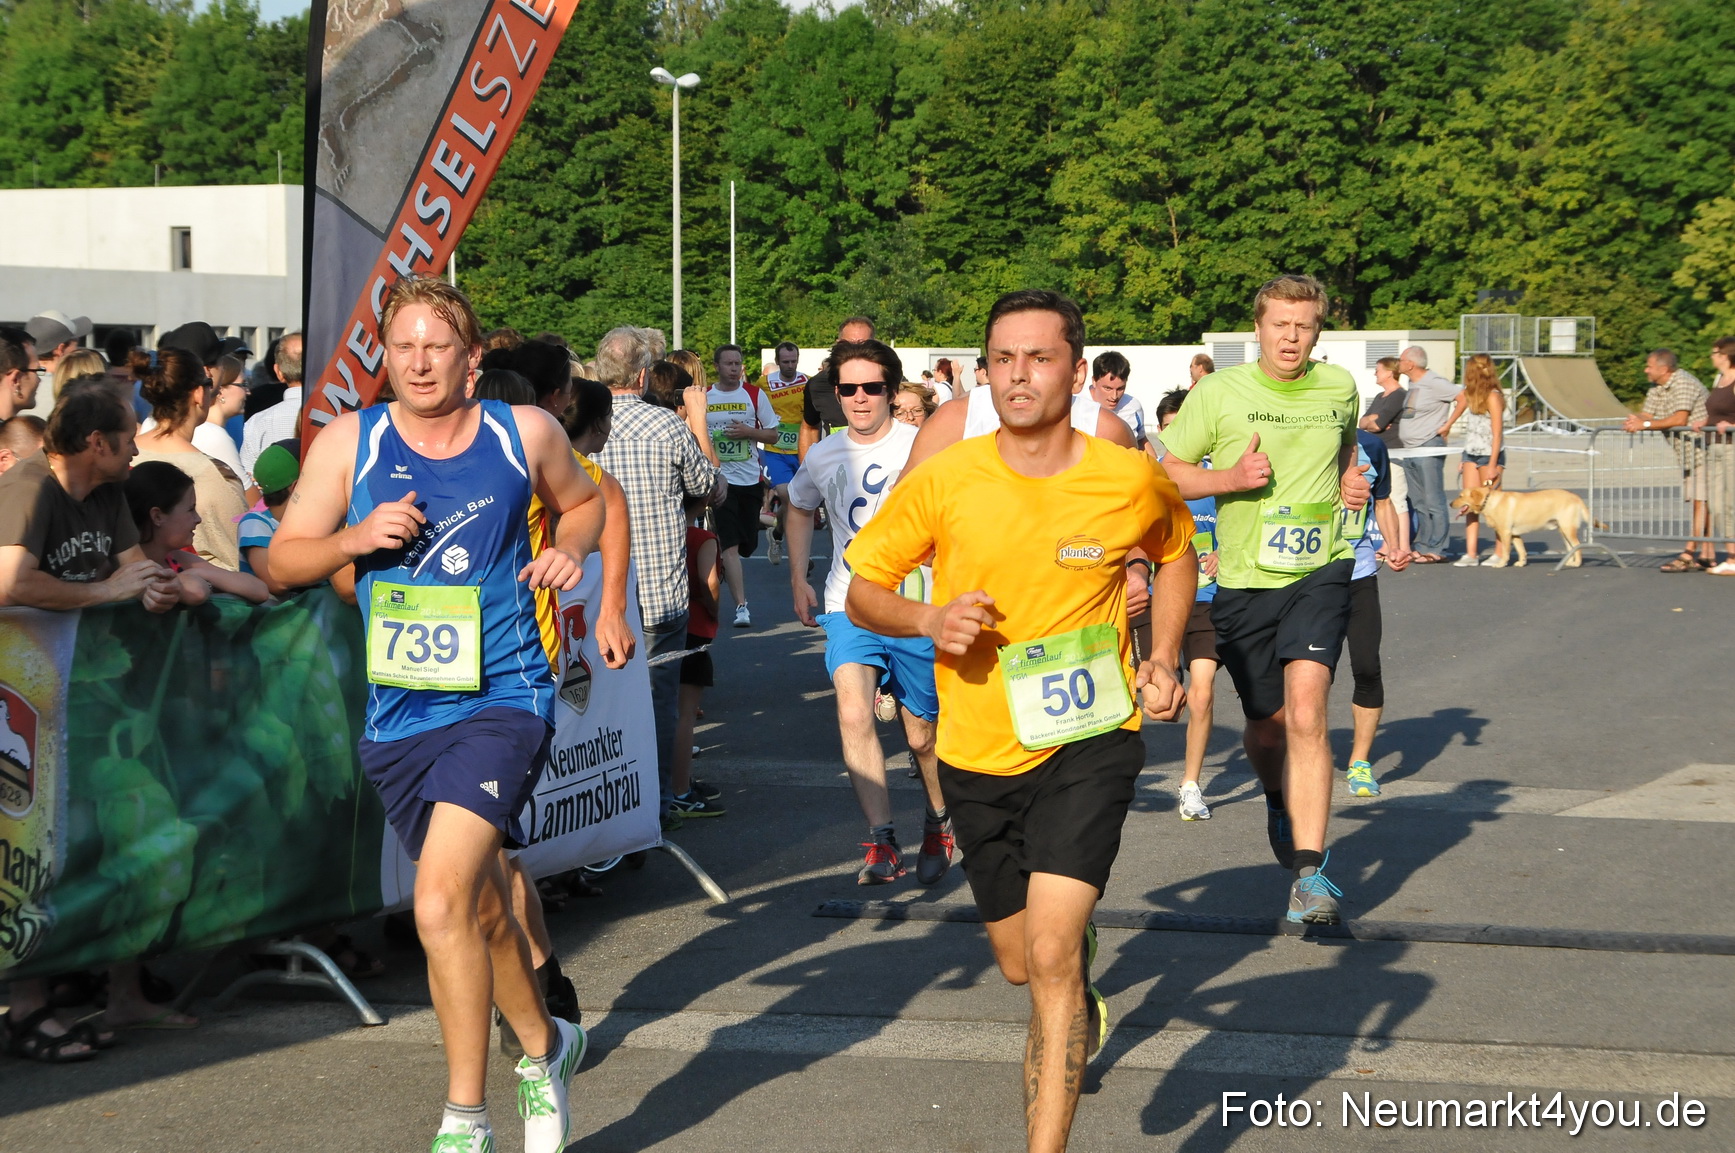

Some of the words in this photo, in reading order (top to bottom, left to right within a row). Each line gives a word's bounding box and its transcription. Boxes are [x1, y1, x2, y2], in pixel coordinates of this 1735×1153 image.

[771, 391, 789, 400] MAX
[708, 403, 743, 412] ONLINE
[1247, 411, 1336, 424] globalconcepts
[778, 431, 797, 444] 769
[718, 441, 742, 454] 921
[398, 540, 426, 570] Team
[424, 510, 466, 539] Schick
[466, 495, 495, 512] Bau
[1267, 526, 1322, 555] 436
[1060, 546, 1090, 560] plank
[384, 600, 419, 611] firmenlauf
[382, 620, 460, 664] 739
[1020, 651, 1063, 668] firmenlauf
[569, 685, 588, 704] 1628
[1041, 668, 1096, 717] 50
[1029, 730, 1056, 741] Bäckerei
[1057, 723, 1087, 735] Konditorei
[1087, 719, 1104, 728] Plank
[1103, 712, 1121, 723] GmbH
[1055, 717, 1075, 726] Frank
[1075, 711, 1095, 722] Hortig
[545, 726, 623, 782] Neumarkter
[480, 783, 499, 799] adidas
[528, 762, 641, 845] Lammsbräu
